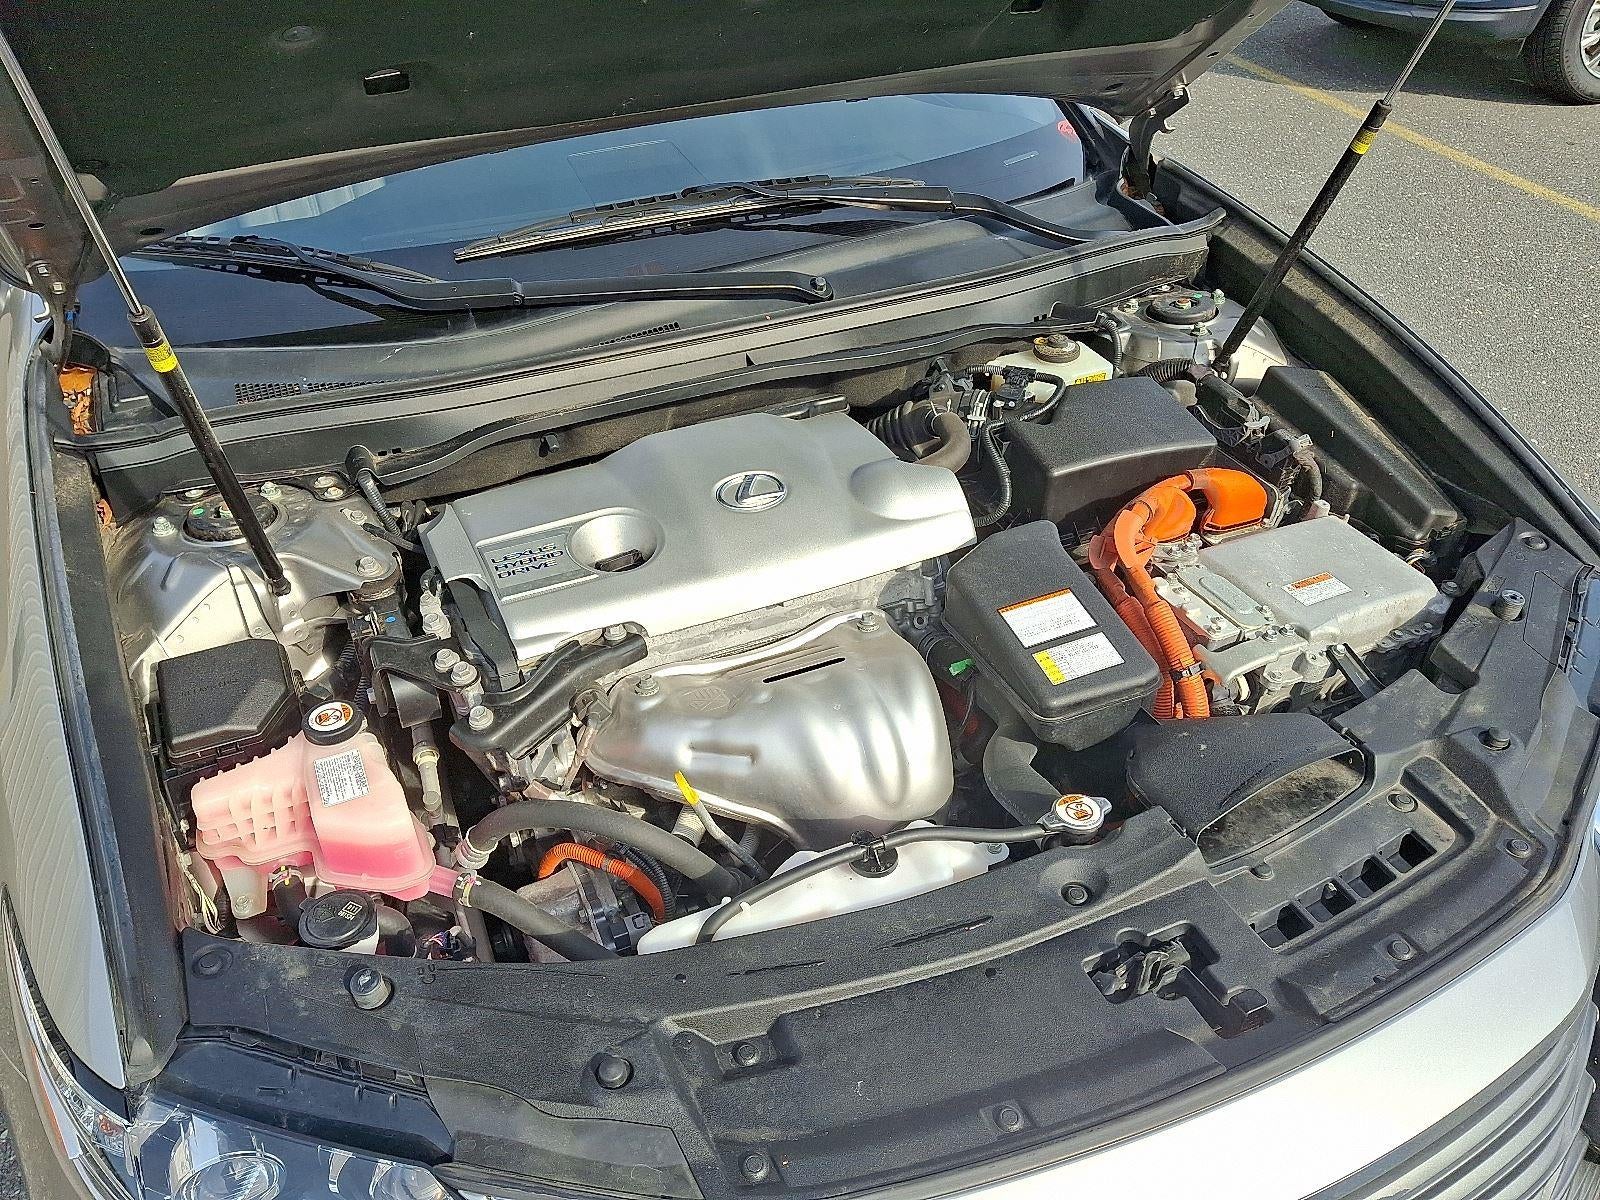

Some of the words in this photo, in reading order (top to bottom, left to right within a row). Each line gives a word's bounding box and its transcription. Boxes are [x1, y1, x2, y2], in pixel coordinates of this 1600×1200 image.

[491, 542, 557, 564] LEXUS
[495, 550, 564, 572] HYBRID
[498, 559, 557, 579] DRIVE
